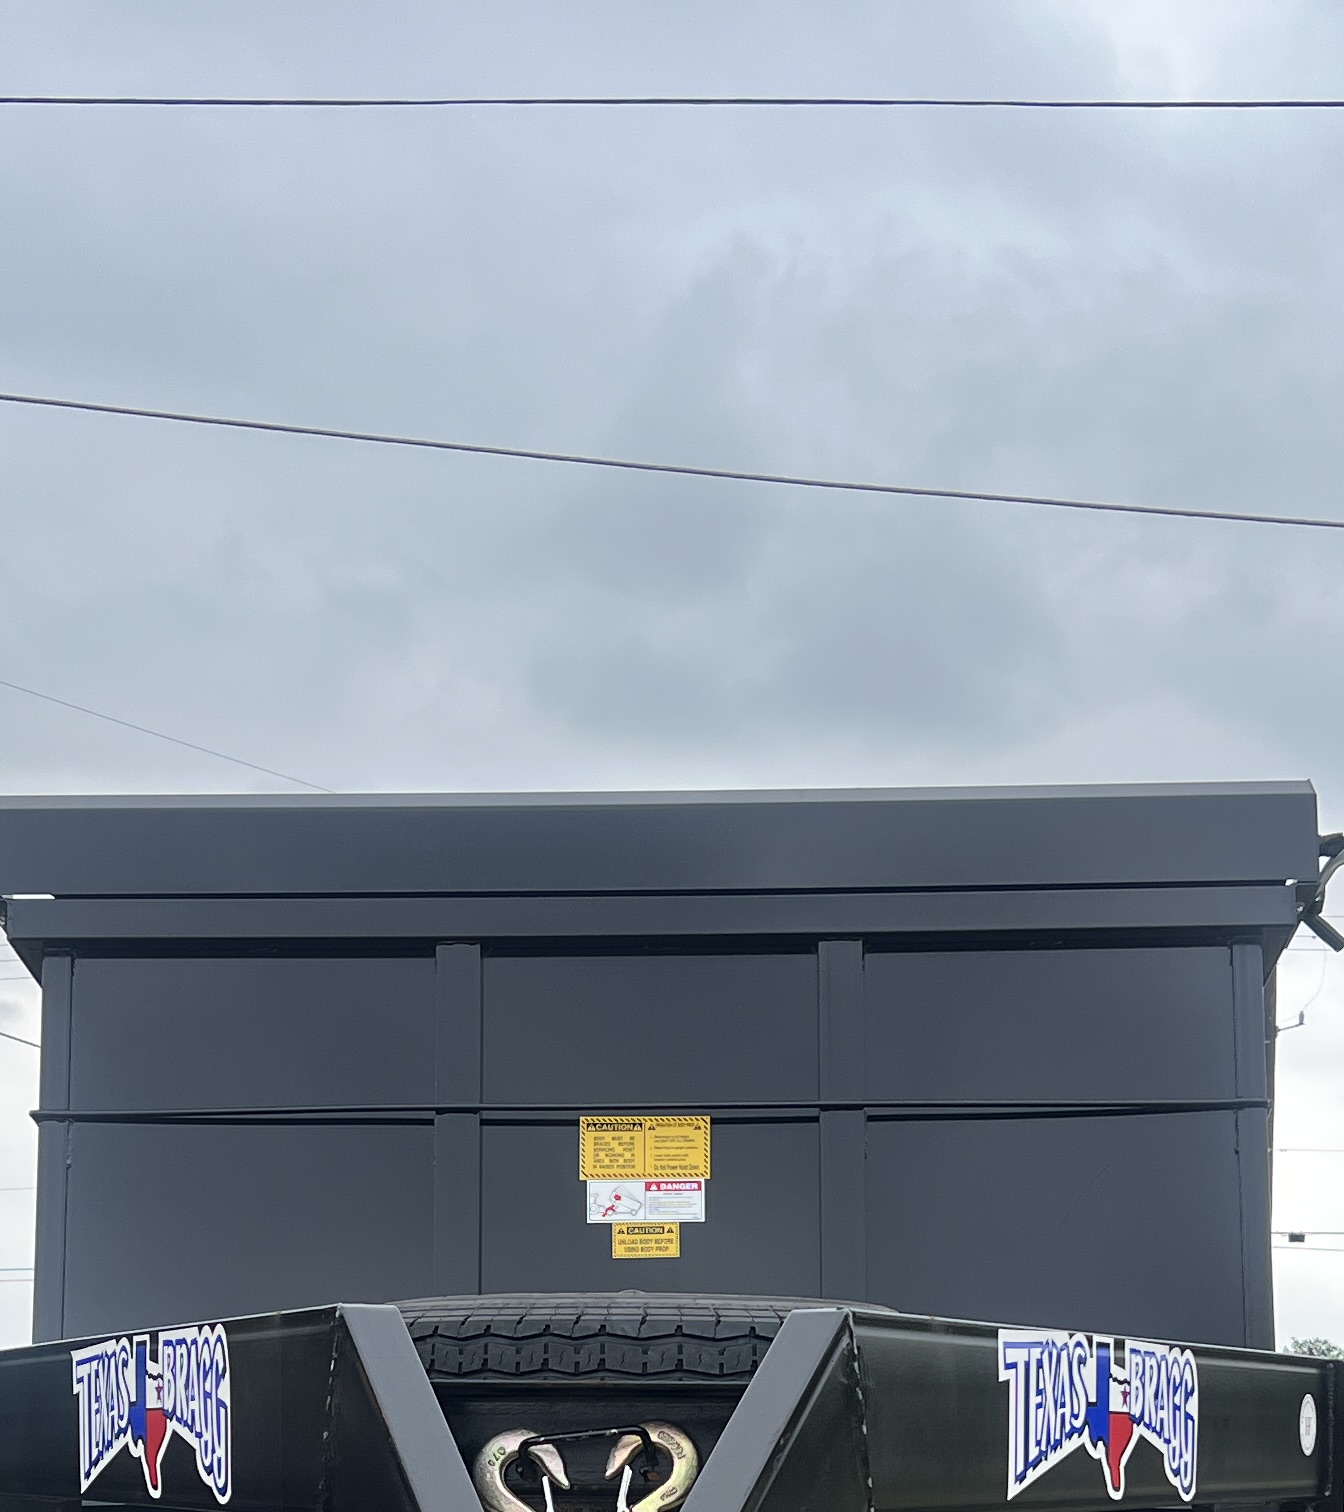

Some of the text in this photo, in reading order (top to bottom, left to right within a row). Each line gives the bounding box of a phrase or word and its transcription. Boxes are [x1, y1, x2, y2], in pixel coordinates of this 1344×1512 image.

[595, 1123, 634, 1131] CAUTION
[659, 1182, 699, 1191] DANGER
[627, 1226, 664, 1235] CAUTION
[74, 1332, 229, 1498] TEXAS BRAGG
[1002, 1339, 1196, 1495] TEXAS BRAGG
